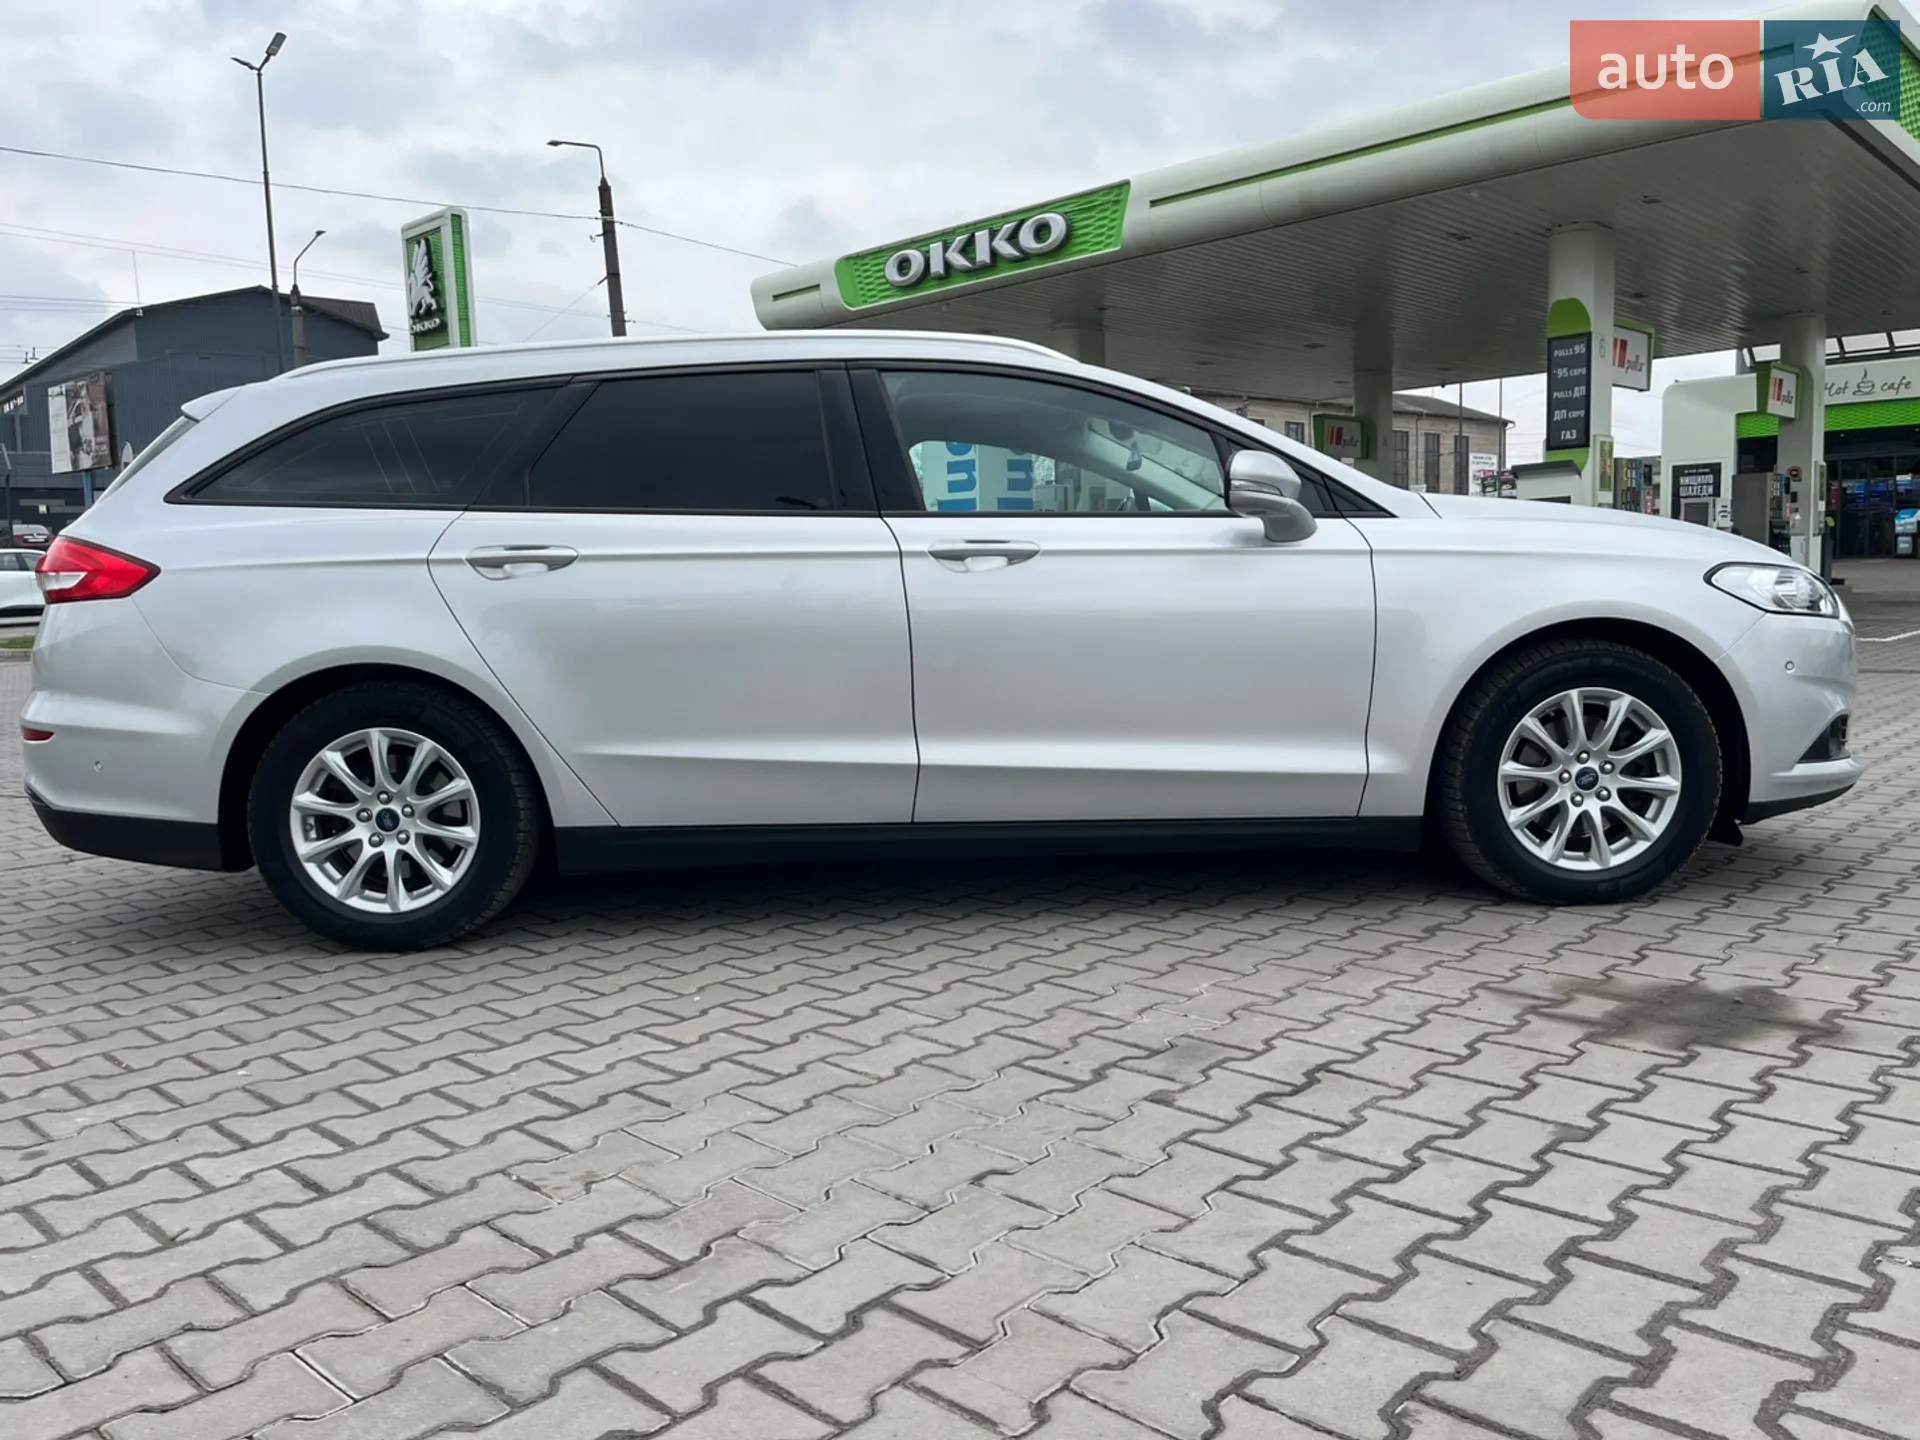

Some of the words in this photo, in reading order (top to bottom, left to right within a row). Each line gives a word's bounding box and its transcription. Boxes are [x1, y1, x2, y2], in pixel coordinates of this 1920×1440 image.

[884, 212, 1070, 288] OKKO
[1554, 348, 1573, 357] PULLS
[1574, 343, 1586, 354] 95
[1881, 375, 1912, 396] cafe
[1553, 390, 1573, 399] PULLS
[1573, 386, 1586, 398] ДП
[1553, 409, 1567, 421] ДП
[1560, 429, 1577, 440] ГАЗ
[1679, 485, 1714, 498] ШАХЕДИ
